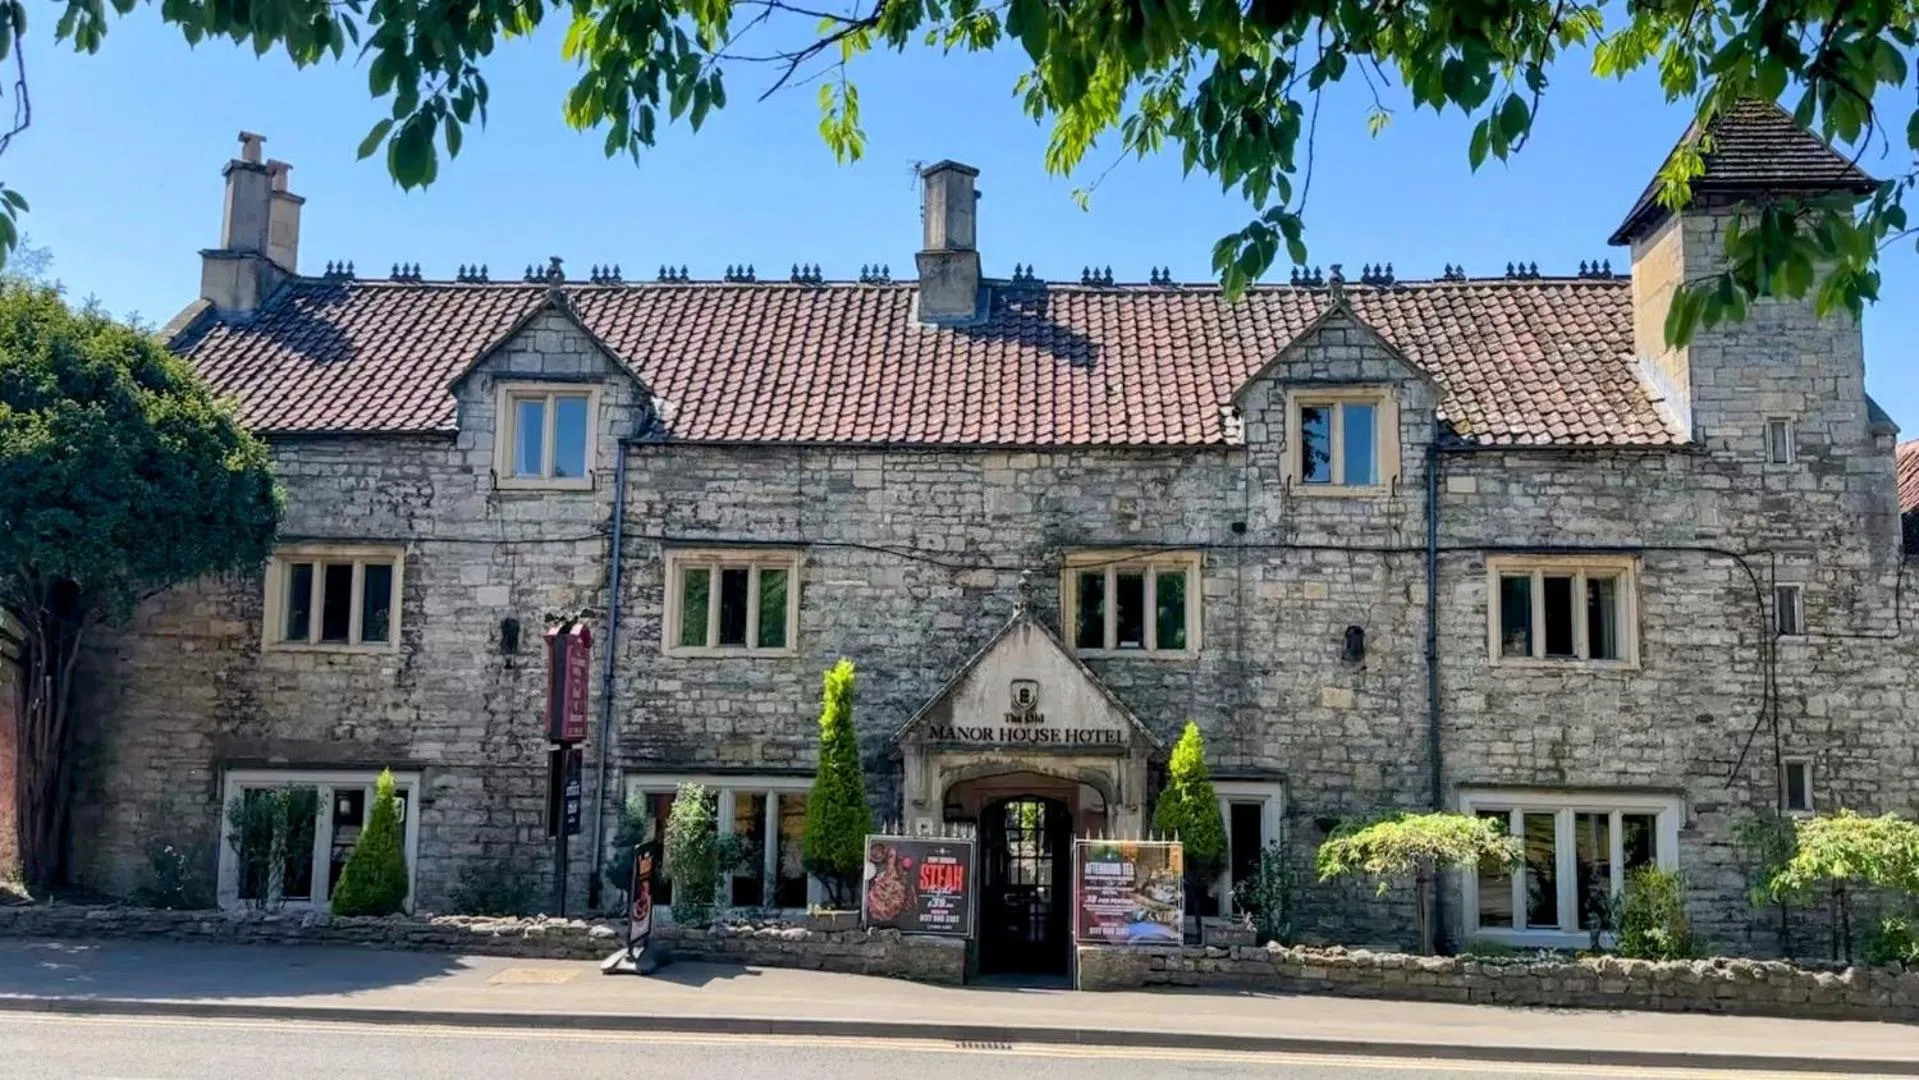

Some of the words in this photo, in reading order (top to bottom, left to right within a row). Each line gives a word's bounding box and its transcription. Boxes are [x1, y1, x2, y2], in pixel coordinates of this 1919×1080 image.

[1003, 711, 1022, 724] The
[1025, 711, 1045, 724] Old
[929, 726, 994, 742] MANOR
[1000, 727, 1061, 743] HOUSE
[1066, 728, 1127, 744] HOTEL
